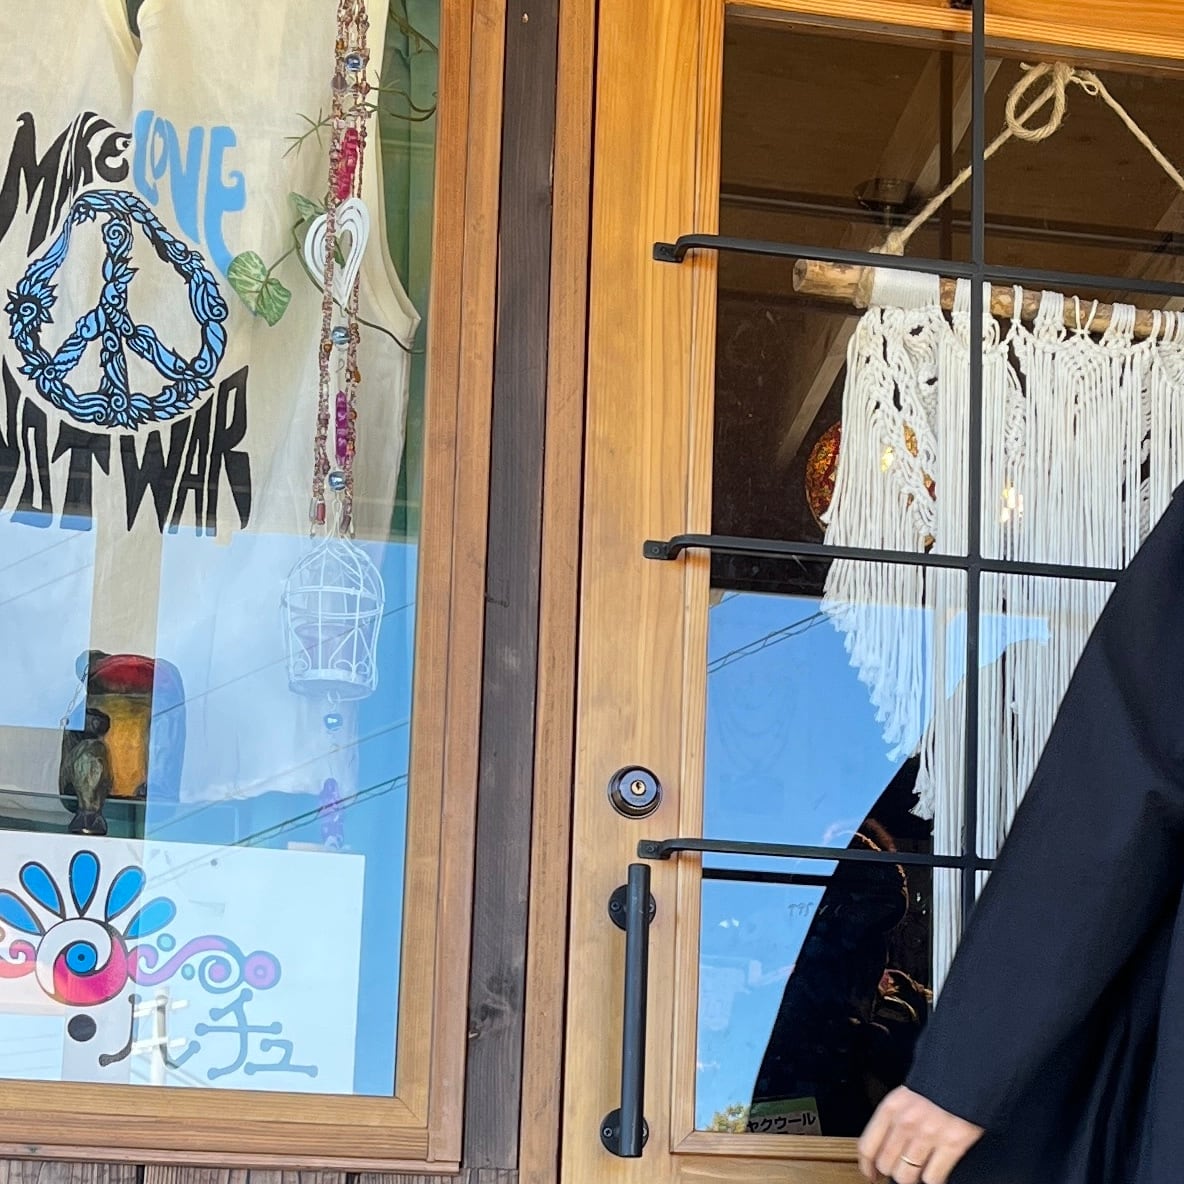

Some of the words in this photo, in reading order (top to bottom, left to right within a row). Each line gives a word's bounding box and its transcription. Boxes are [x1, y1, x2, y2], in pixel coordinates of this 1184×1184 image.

[0, 111, 133, 258] MAKE
[133, 110, 247, 278] LOVE
[120, 366, 251, 537] WAR
